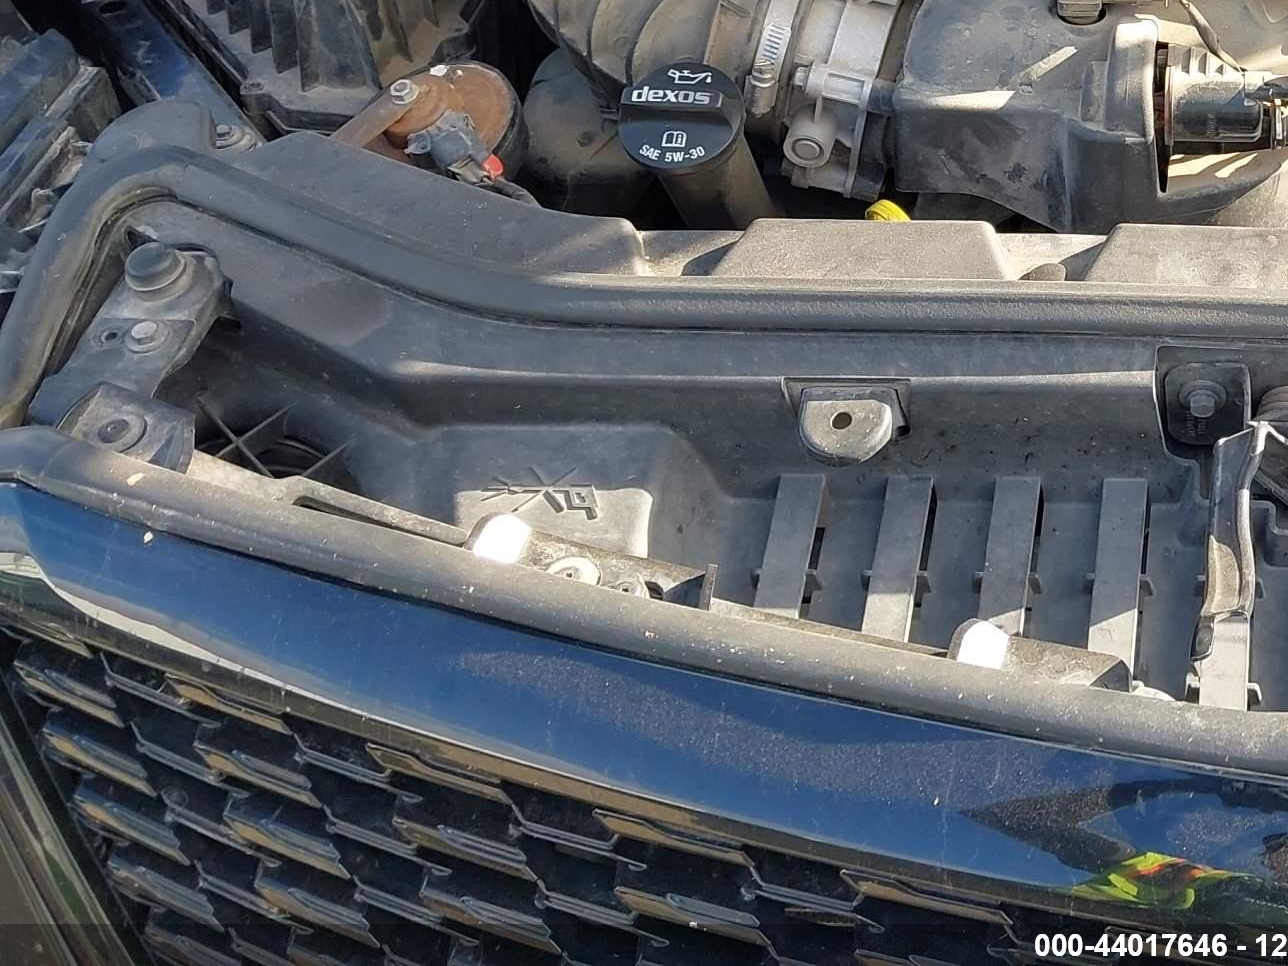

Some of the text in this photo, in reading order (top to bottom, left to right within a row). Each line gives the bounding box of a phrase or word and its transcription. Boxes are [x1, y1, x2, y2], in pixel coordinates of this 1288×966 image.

[631, 85, 714, 105] dexos
[639, 144, 705, 163] SAE 5W-30
